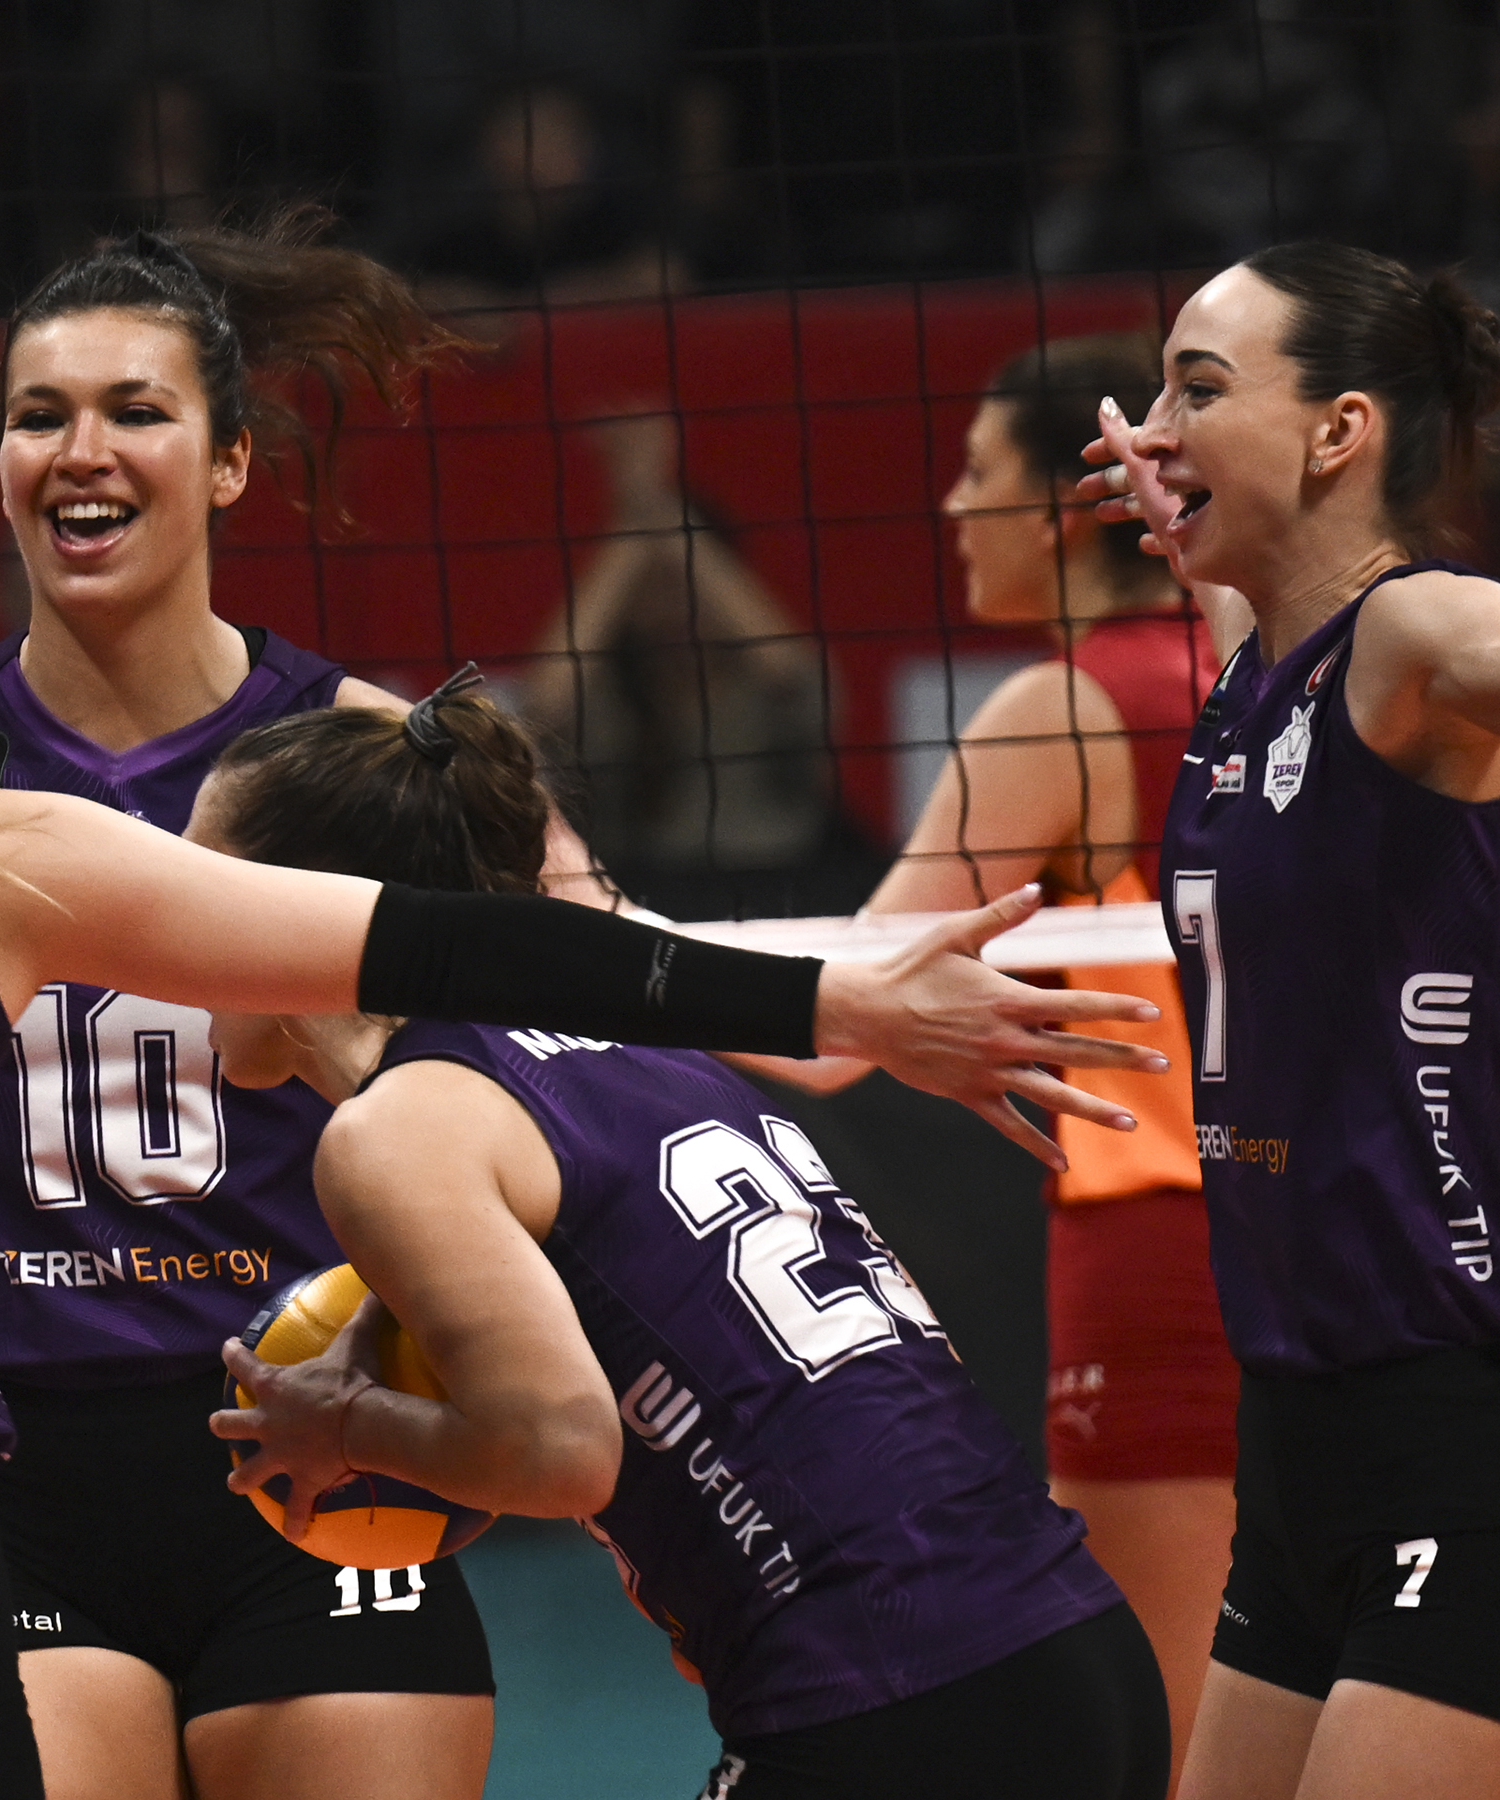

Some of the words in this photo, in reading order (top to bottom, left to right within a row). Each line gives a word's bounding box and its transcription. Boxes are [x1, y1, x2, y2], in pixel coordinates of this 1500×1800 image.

[1272, 763, 1303, 780] ZEREN
[1172, 869, 1227, 1083] 7
[11, 984, 227, 1211] 10
[1195, 1124, 1232, 1159] EREN
[1230, 1126, 1289, 1174] Energy
[1415, 1065, 1473, 1196] UFUK
[1447, 1204, 1494, 1283] TIP
[129, 1246, 272, 1285] Energy
[658, 1114, 947, 1383] 23
[688, 1437, 774, 1558] UFUK
[329, 1563, 427, 1617] 10
[1393, 1537, 1439, 1608] 7
[12, 1609, 63, 1633] tal
